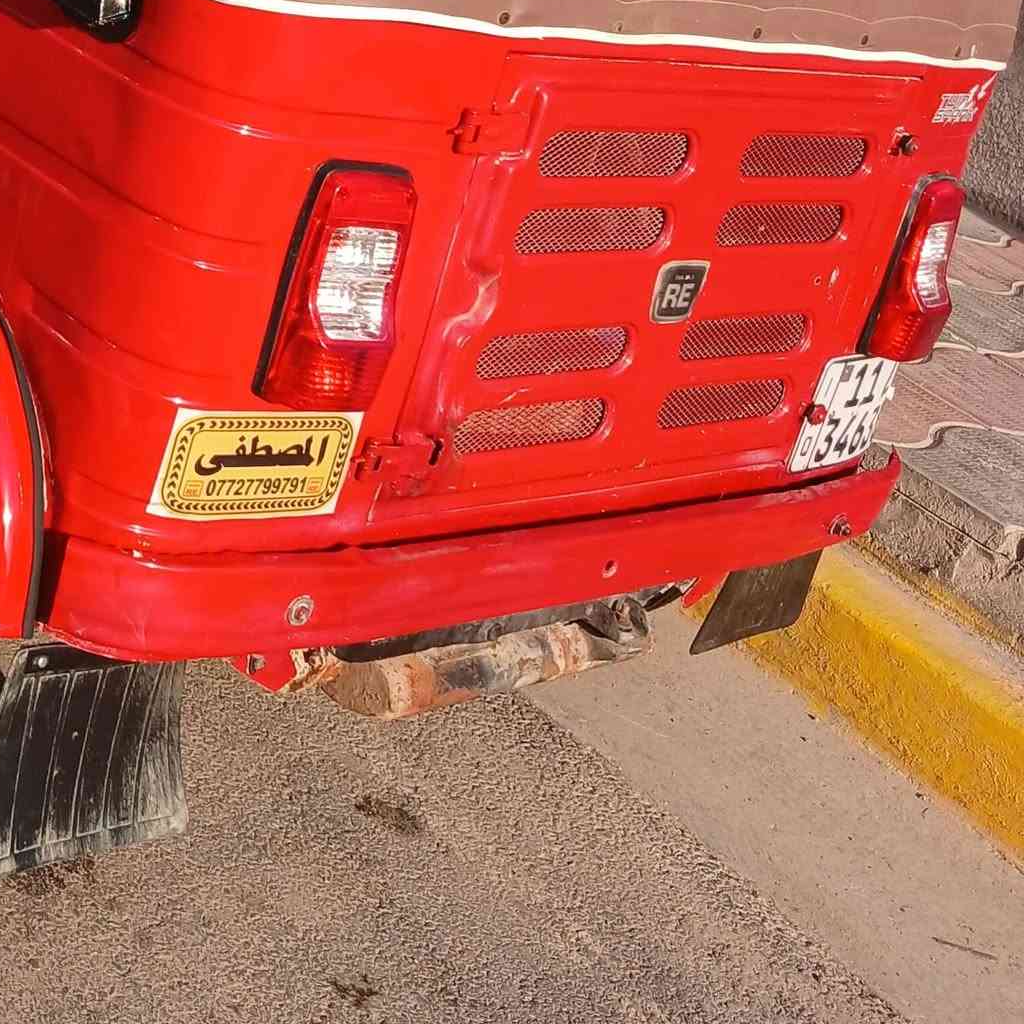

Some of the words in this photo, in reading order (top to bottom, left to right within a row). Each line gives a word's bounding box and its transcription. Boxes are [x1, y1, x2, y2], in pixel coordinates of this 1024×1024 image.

[661, 283, 696, 309] RE
[194, 434, 330, 476] المصطفى
[205, 477, 308, 497] 07727799791
